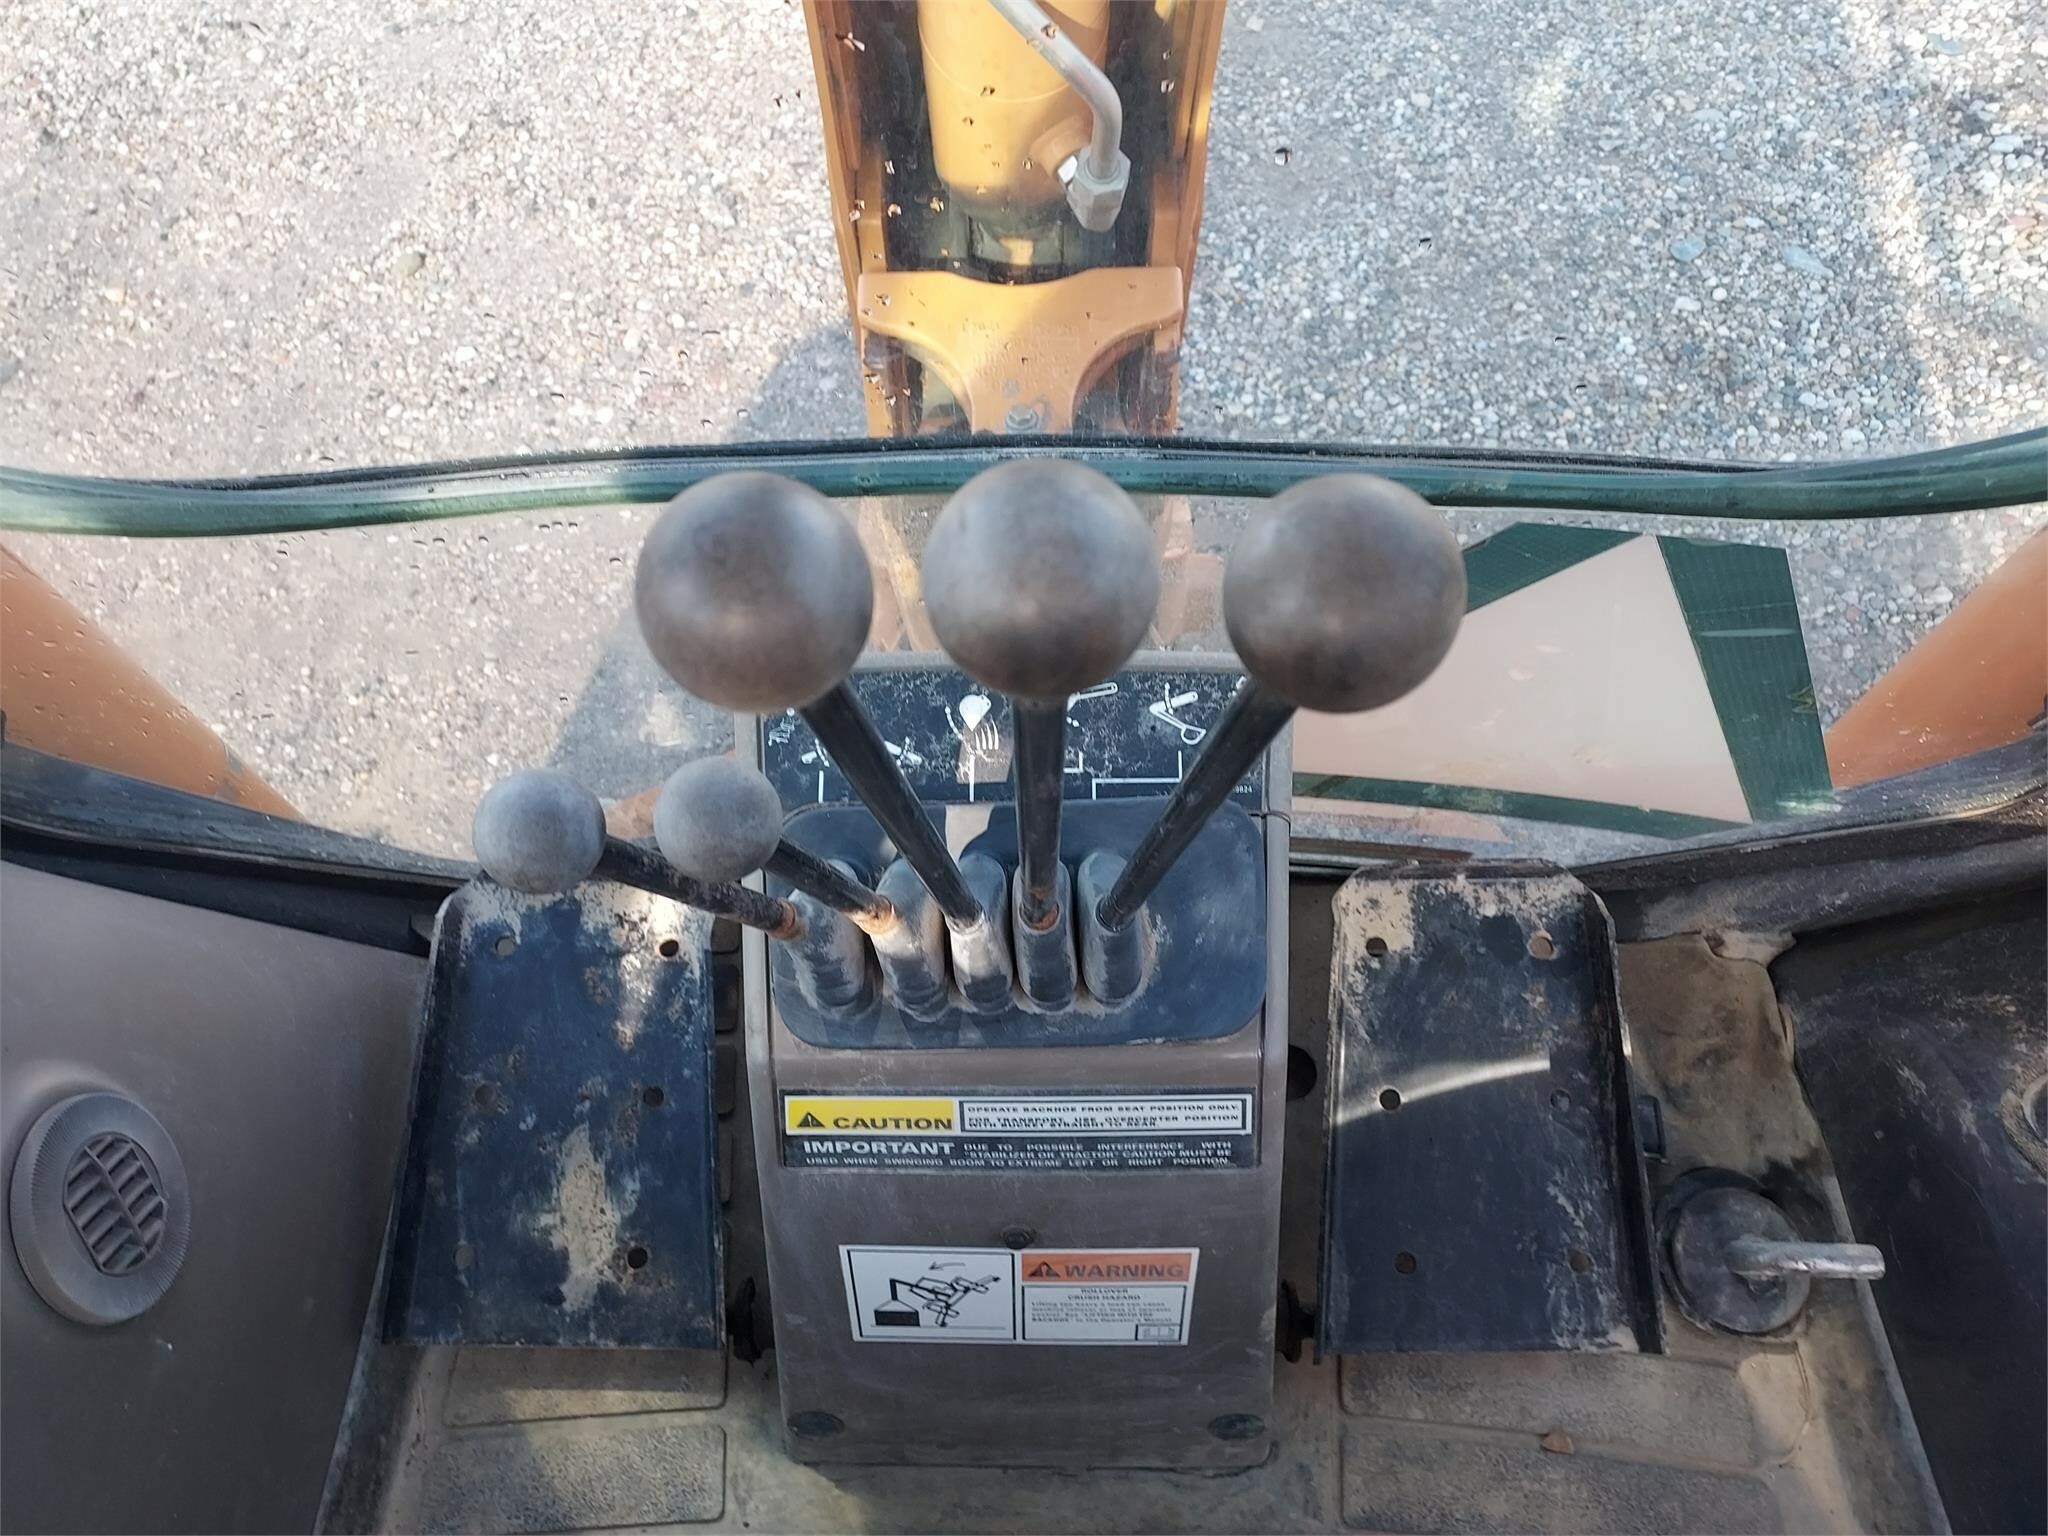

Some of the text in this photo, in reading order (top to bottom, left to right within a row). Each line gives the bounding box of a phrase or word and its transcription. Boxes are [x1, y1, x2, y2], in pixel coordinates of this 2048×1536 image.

[967, 1105, 1018, 1113] OPERATE
[1023, 1105, 1077, 1113] BACKHOE
[1117, 1104, 1144, 1112] SEAT
[833, 1116, 954, 1130] CAUTION
[802, 1140, 956, 1155] IMPORTANT
[963, 1141, 1232, 1152] DUE TO POSSIBLE INTERFERENCE WITH
[1037, 1151, 1056, 1159] OR
[1122, 1150, 1176, 1158] CAUTION
[1179, 1150, 1214, 1158] MUST
[1216, 1149, 1232, 1157] BE
[805, 1156, 839, 1165] USED
[842, 1157, 879, 1165] WHEN
[883, 1158, 944, 1166] SWINGING
[949, 1158, 985, 1167] BOOM
[990, 1158, 1005, 1167] TO
[1008, 1158, 1062, 1167] EXTREME
[1068, 1158, 1095, 1167] LEFT
[1101, 1158, 1119, 1167] OR
[1127, 1158, 1163, 1166] RIGHT
[1064, 1263, 1184, 1278] WARNING
